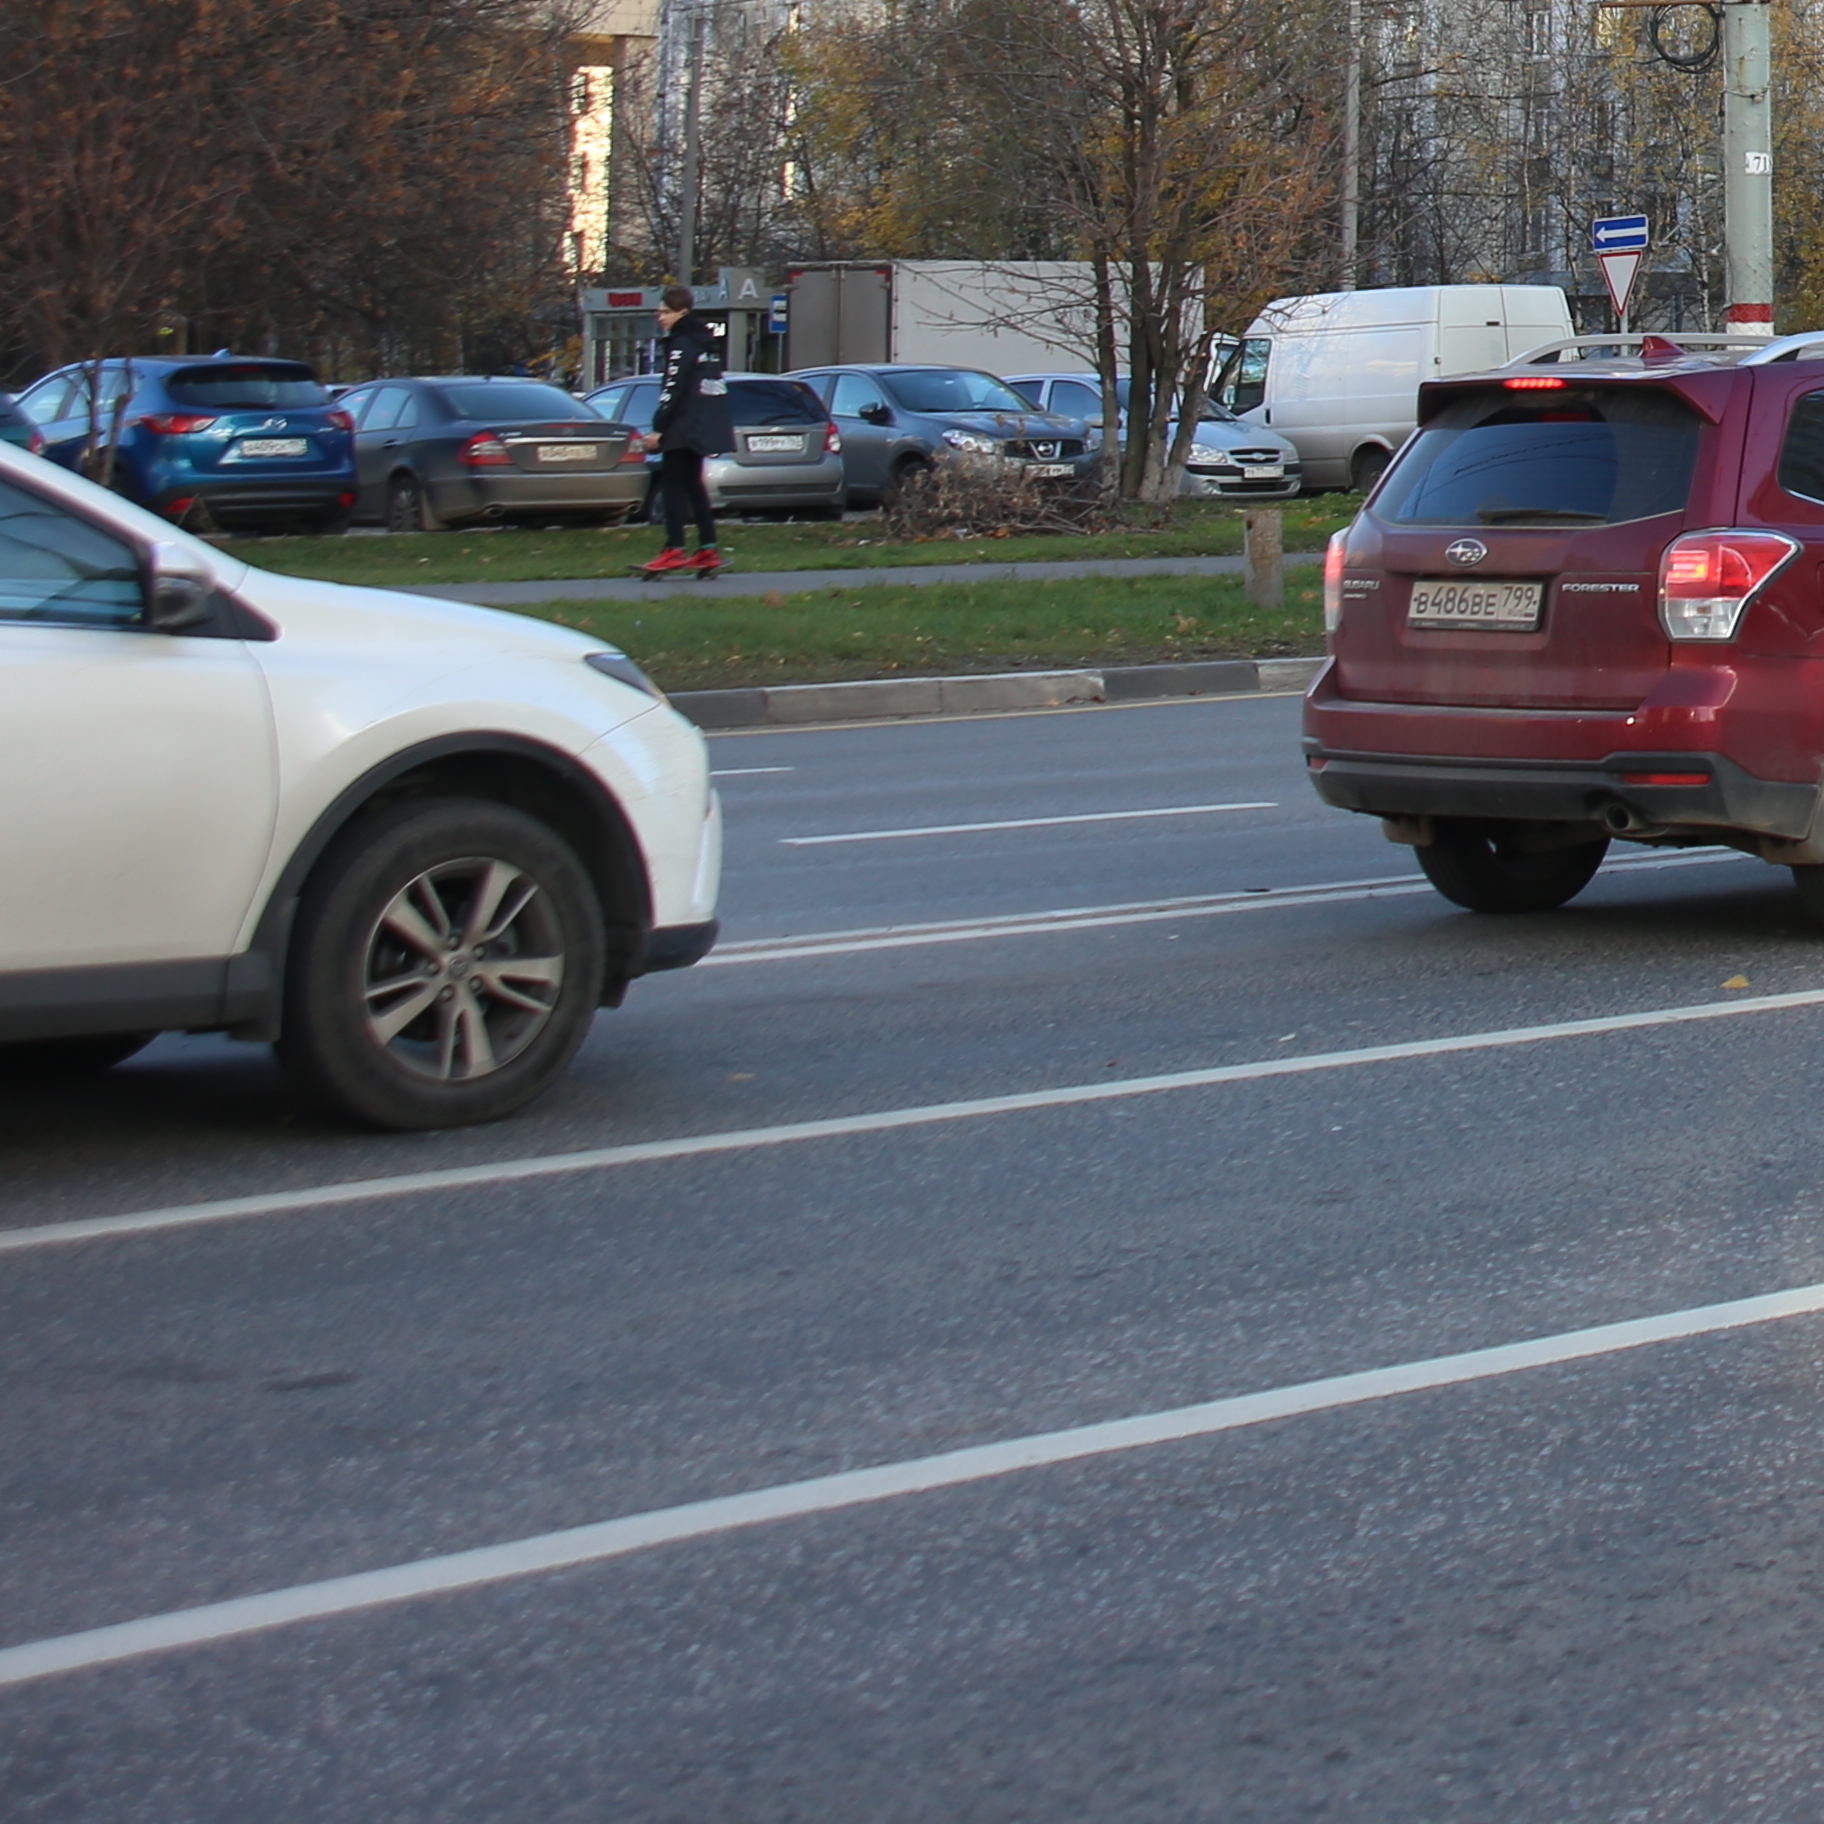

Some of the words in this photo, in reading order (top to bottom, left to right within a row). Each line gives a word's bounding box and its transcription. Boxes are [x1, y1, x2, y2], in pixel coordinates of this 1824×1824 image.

[1343, 579, 1381, 590] SUBARU
[1561, 582, 1641, 593] FORESTER
[1416, 586, 1498, 616] В486ВЕ
[1501, 586, 1534, 609] 799
